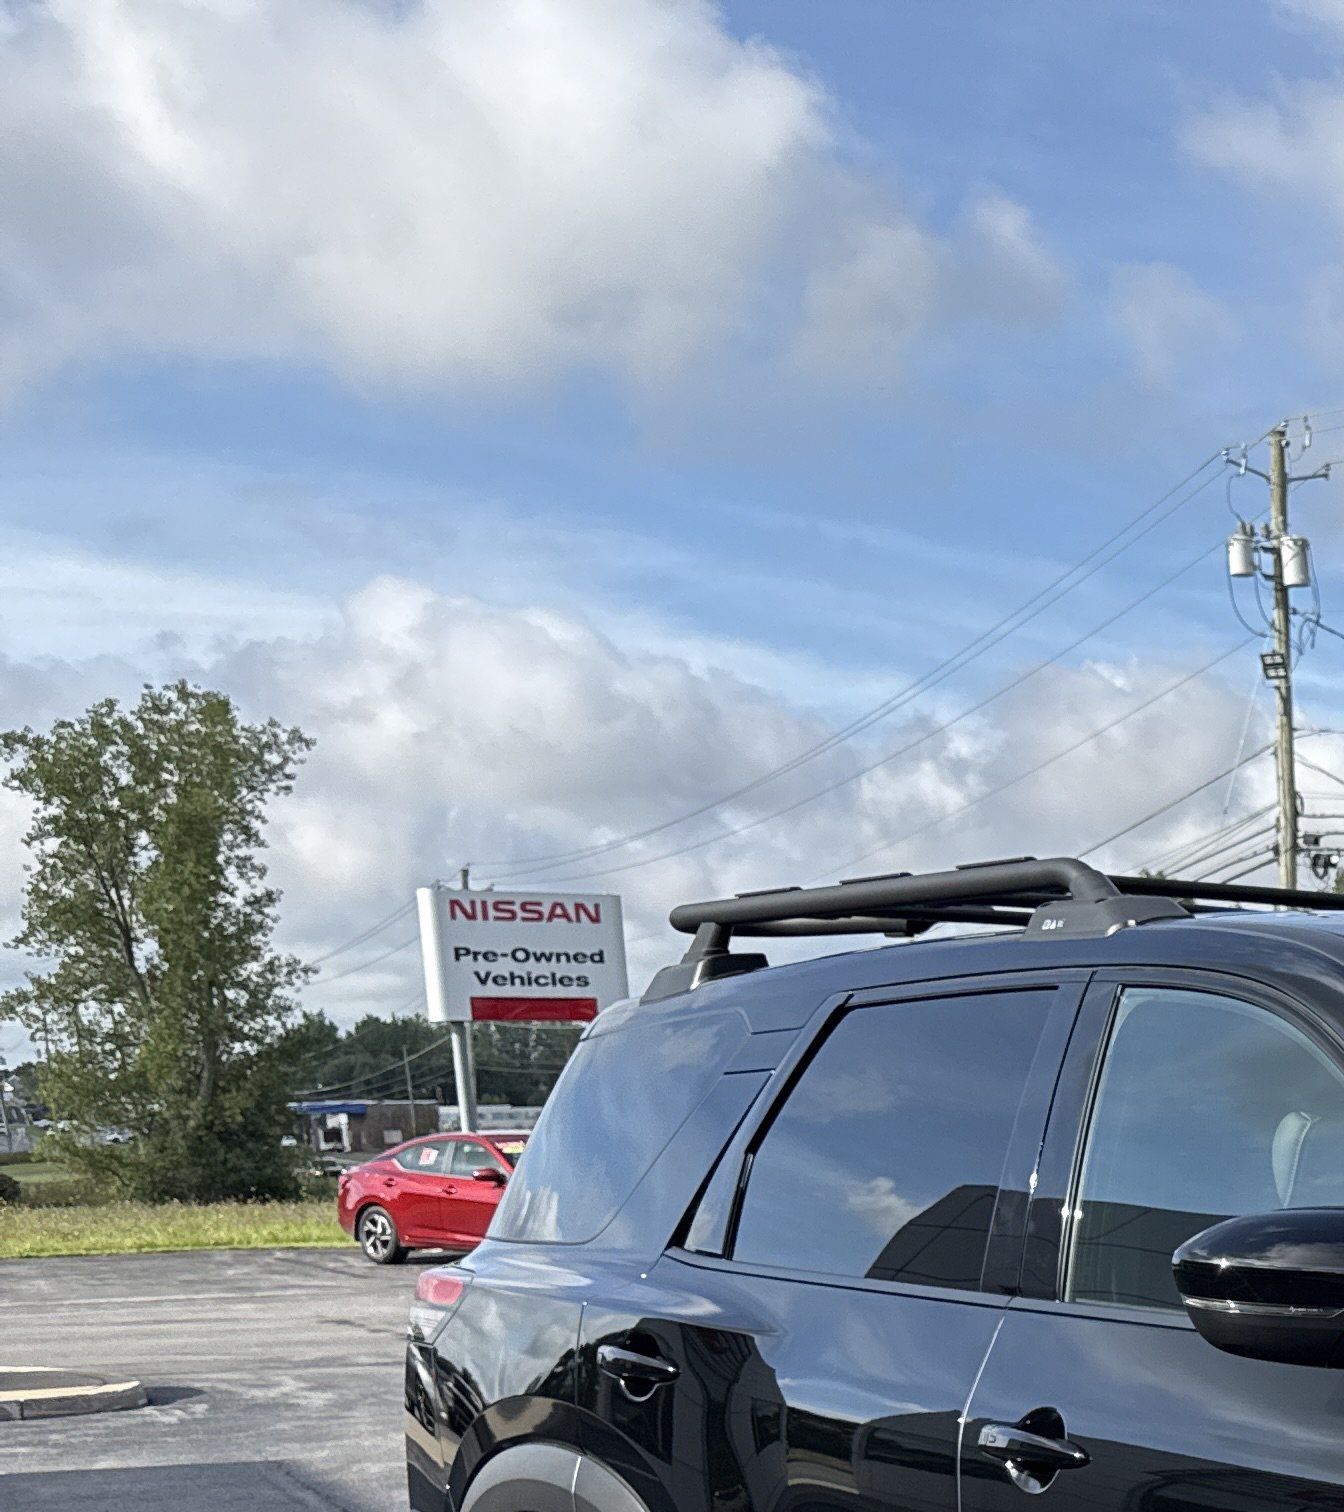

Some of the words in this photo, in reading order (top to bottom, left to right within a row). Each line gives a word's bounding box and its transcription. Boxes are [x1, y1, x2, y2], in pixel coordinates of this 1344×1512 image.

[449, 899, 601, 924] NISSAN
[454, 946, 605, 964] Pre-Owned
[473, 971, 590, 987] Vehicles
